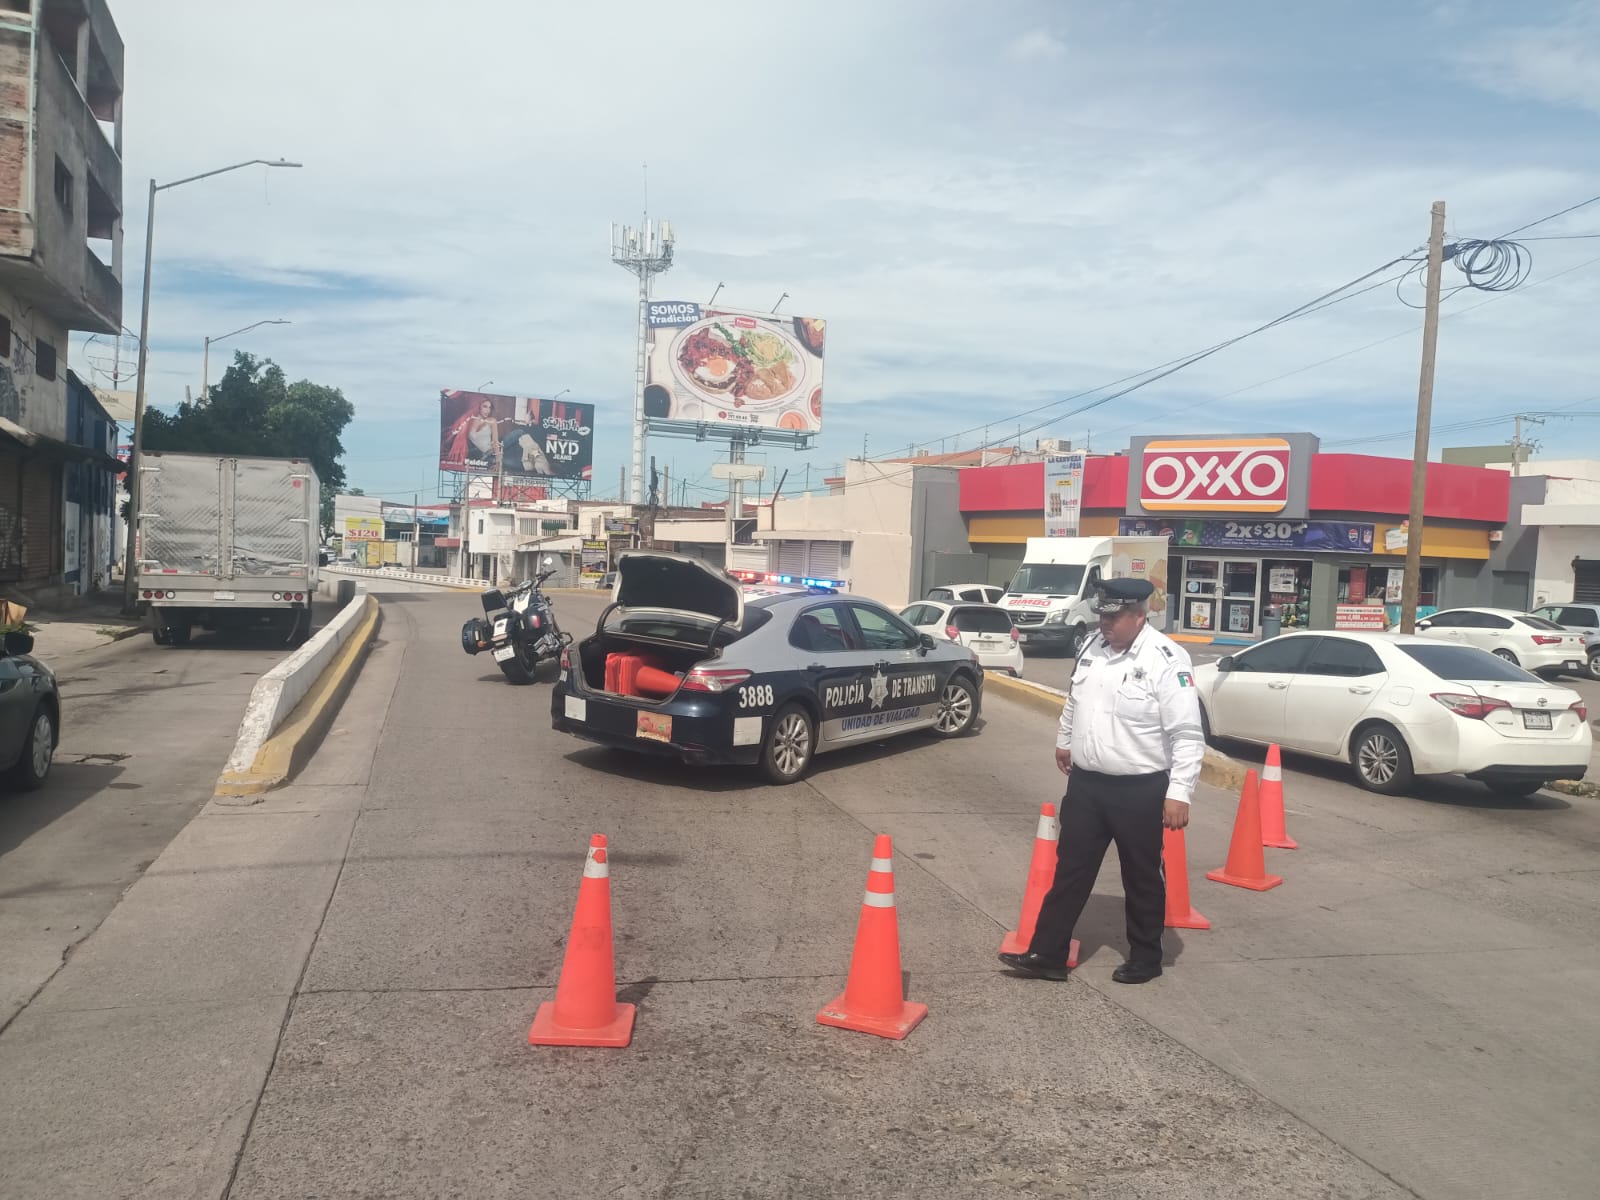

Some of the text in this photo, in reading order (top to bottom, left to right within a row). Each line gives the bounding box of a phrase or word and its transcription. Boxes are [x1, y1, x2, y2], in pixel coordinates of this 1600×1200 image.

[651, 304, 695, 315] SOMOS
[650, 314, 699, 324] Tradición
[546, 440, 579, 456] NYD
[1146, 453, 1285, 498] OXXO
[348, 528, 379, 538] $120
[1225, 522, 1292, 539] 2x$30
[738, 685, 774, 708] 3888
[825, 673, 936, 708] POLICÍA DE TRANSITO
[841, 706, 921, 731] UNIDAD DE VIALIDAD
